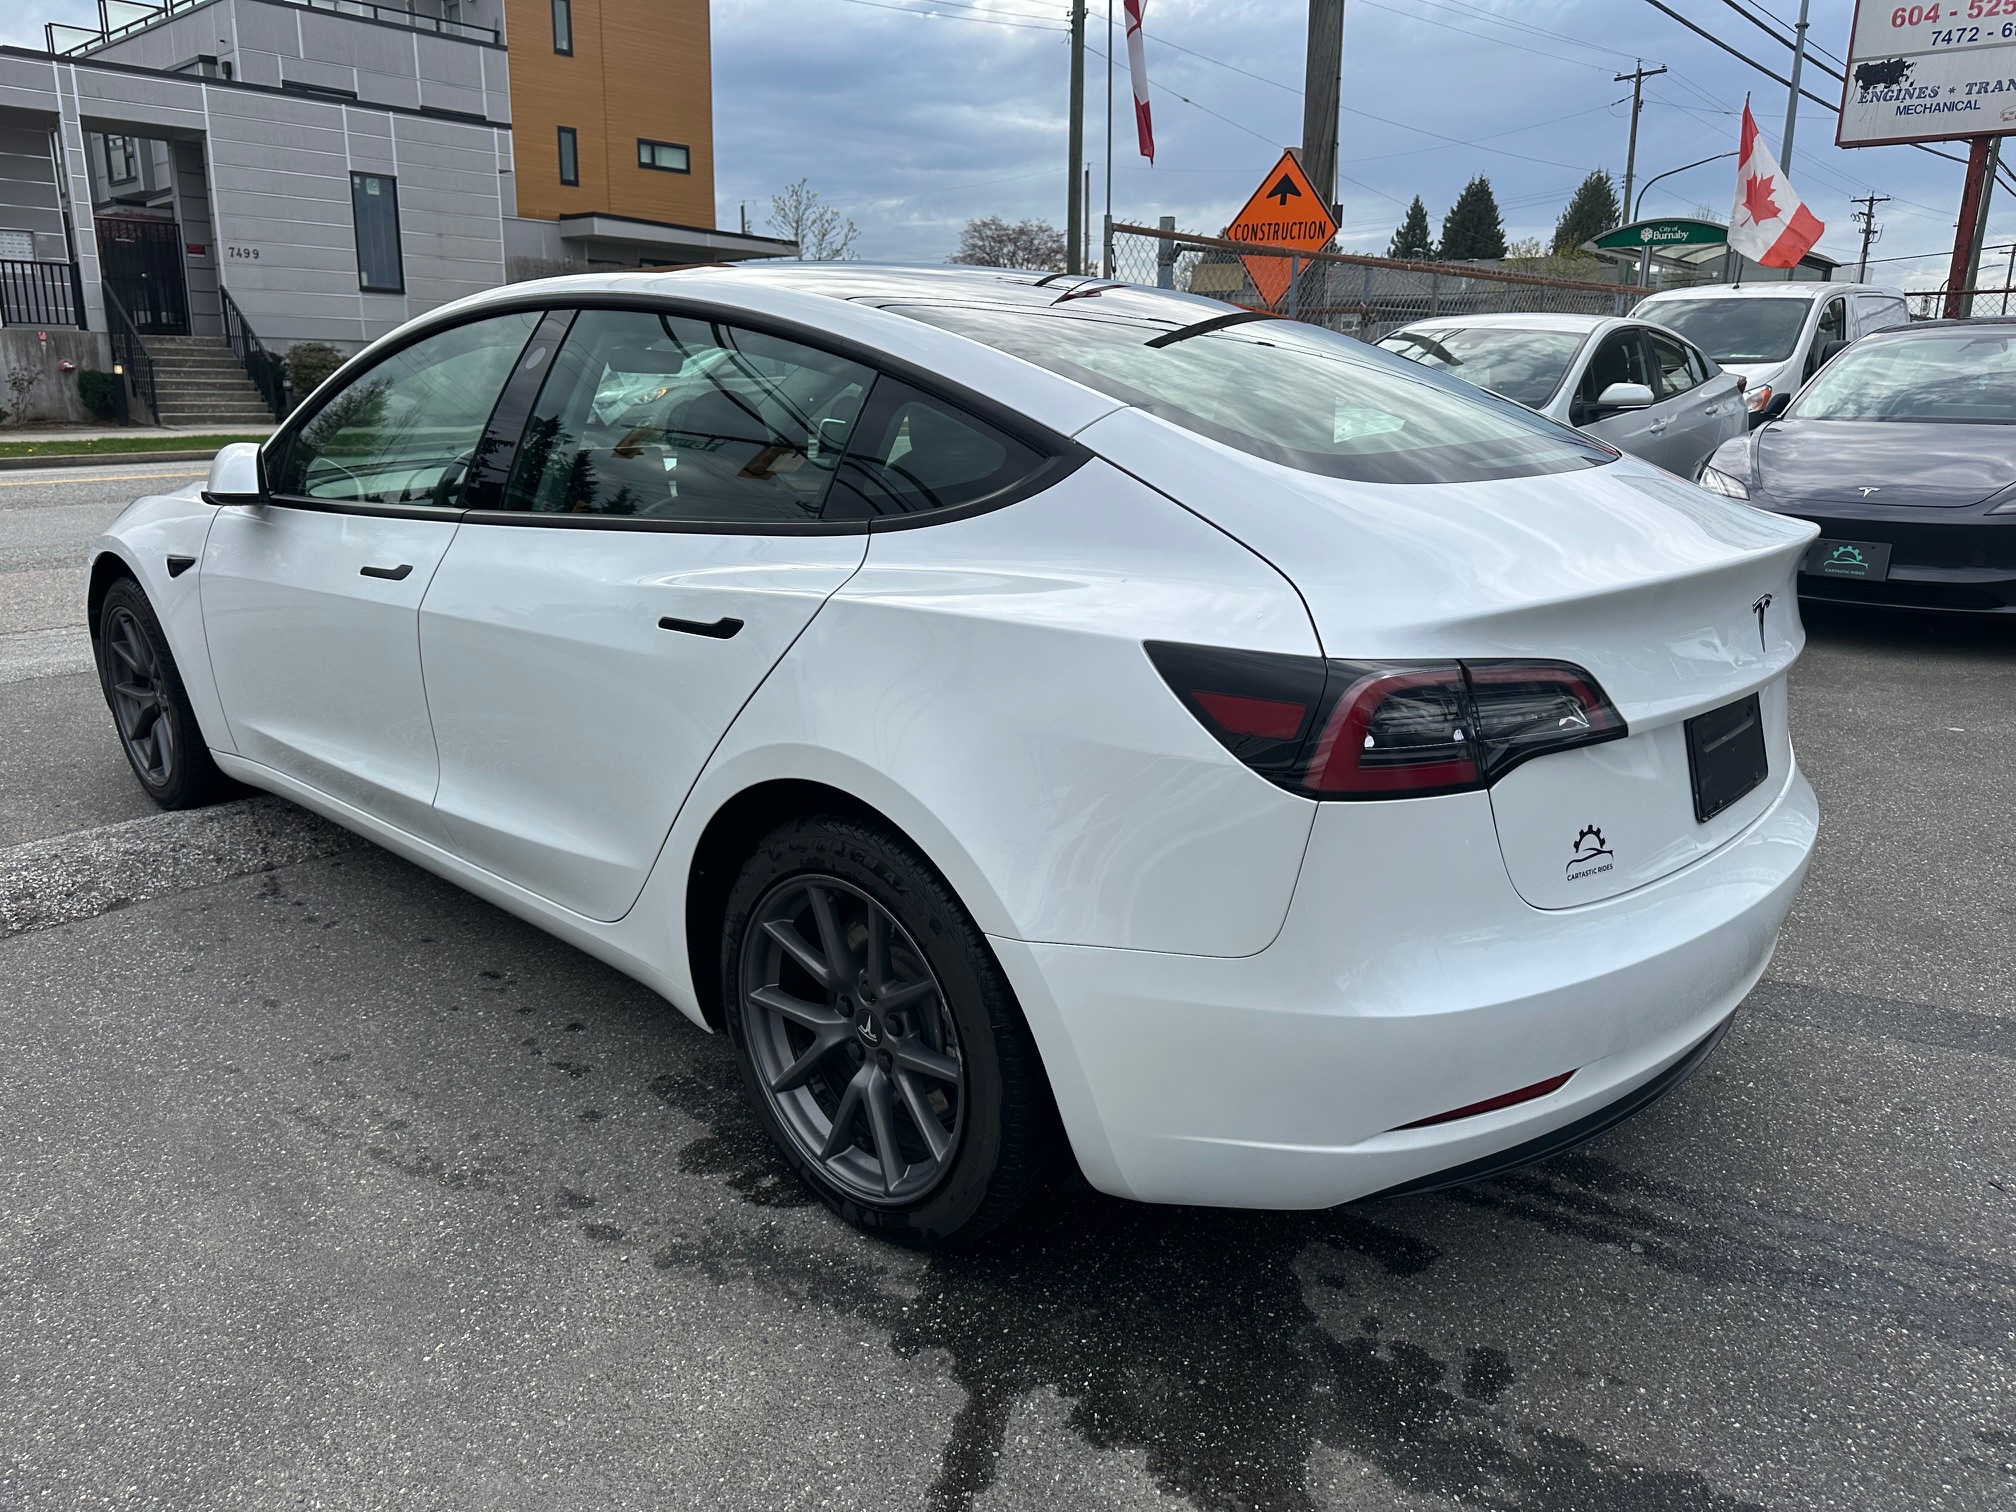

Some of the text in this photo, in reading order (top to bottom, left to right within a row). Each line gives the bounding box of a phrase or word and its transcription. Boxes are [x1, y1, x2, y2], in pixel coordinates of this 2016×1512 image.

[1891, 2, 1941, 28] 604
[1967, 0, 2016, 19] 525
[1931, 26, 1980, 46] 7472
[2001, 22, 2016, 38] 6
[1857, 84, 1941, 104] ENGINES
[1895, 99, 1981, 116] MECHANICAL
[1234, 221, 1327, 241] CONSTRUCTION
[1653, 230, 1689, 241] Burnaby
[228, 246, 260, 259] 7499
[1567, 863, 1613, 881] CARTASTIC RIDES
